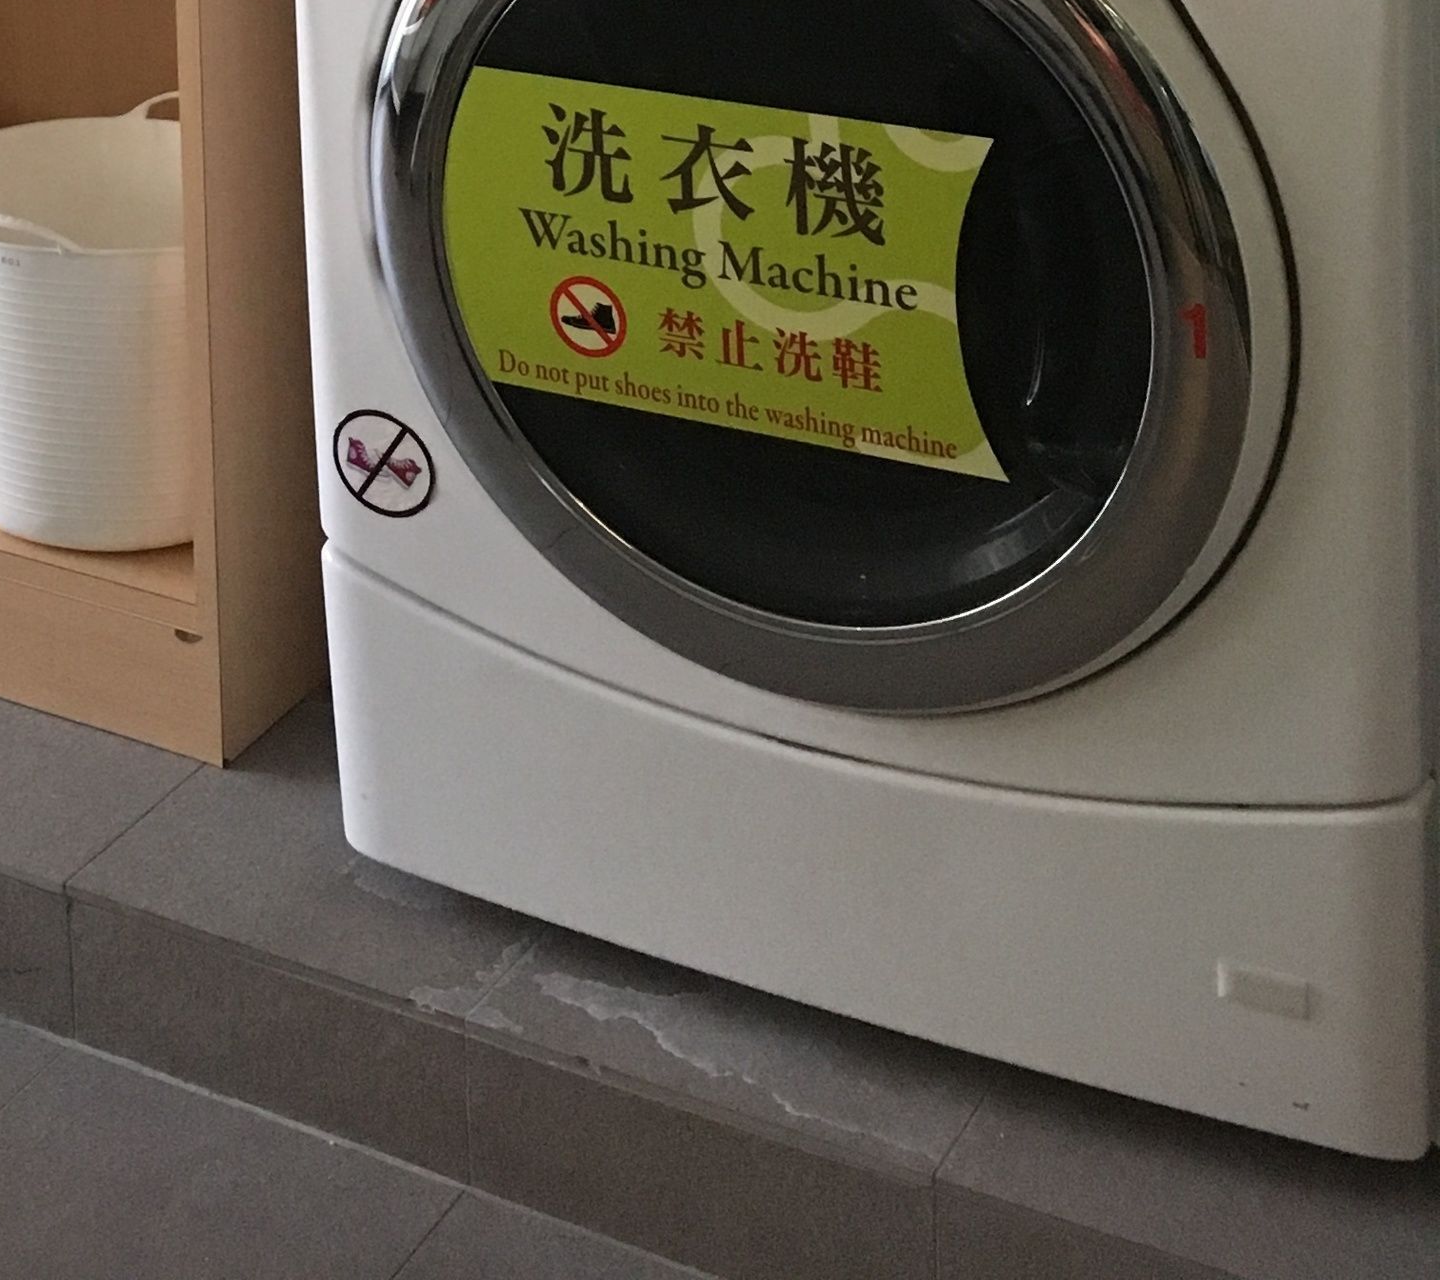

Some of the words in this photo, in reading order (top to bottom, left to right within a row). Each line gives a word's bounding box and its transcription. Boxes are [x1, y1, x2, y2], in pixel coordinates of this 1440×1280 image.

[541, 103, 886, 246] 洗衣機
[519, 207, 707, 290] Washing
[718, 240, 918, 311] Machine
[658, 307, 883, 393] 禁止洗鞋
[1181, 303, 1207, 359] 1
[499, 348, 529, 377] Do
[536, 359, 570, 385] not
[575, 370, 609, 395] put
[615, 371, 671, 405] shoes
[677, 384, 719, 414] into
[727, 392, 760, 421] the
[765, 408, 856, 447] washing
[861, 425, 958, 459] machine
